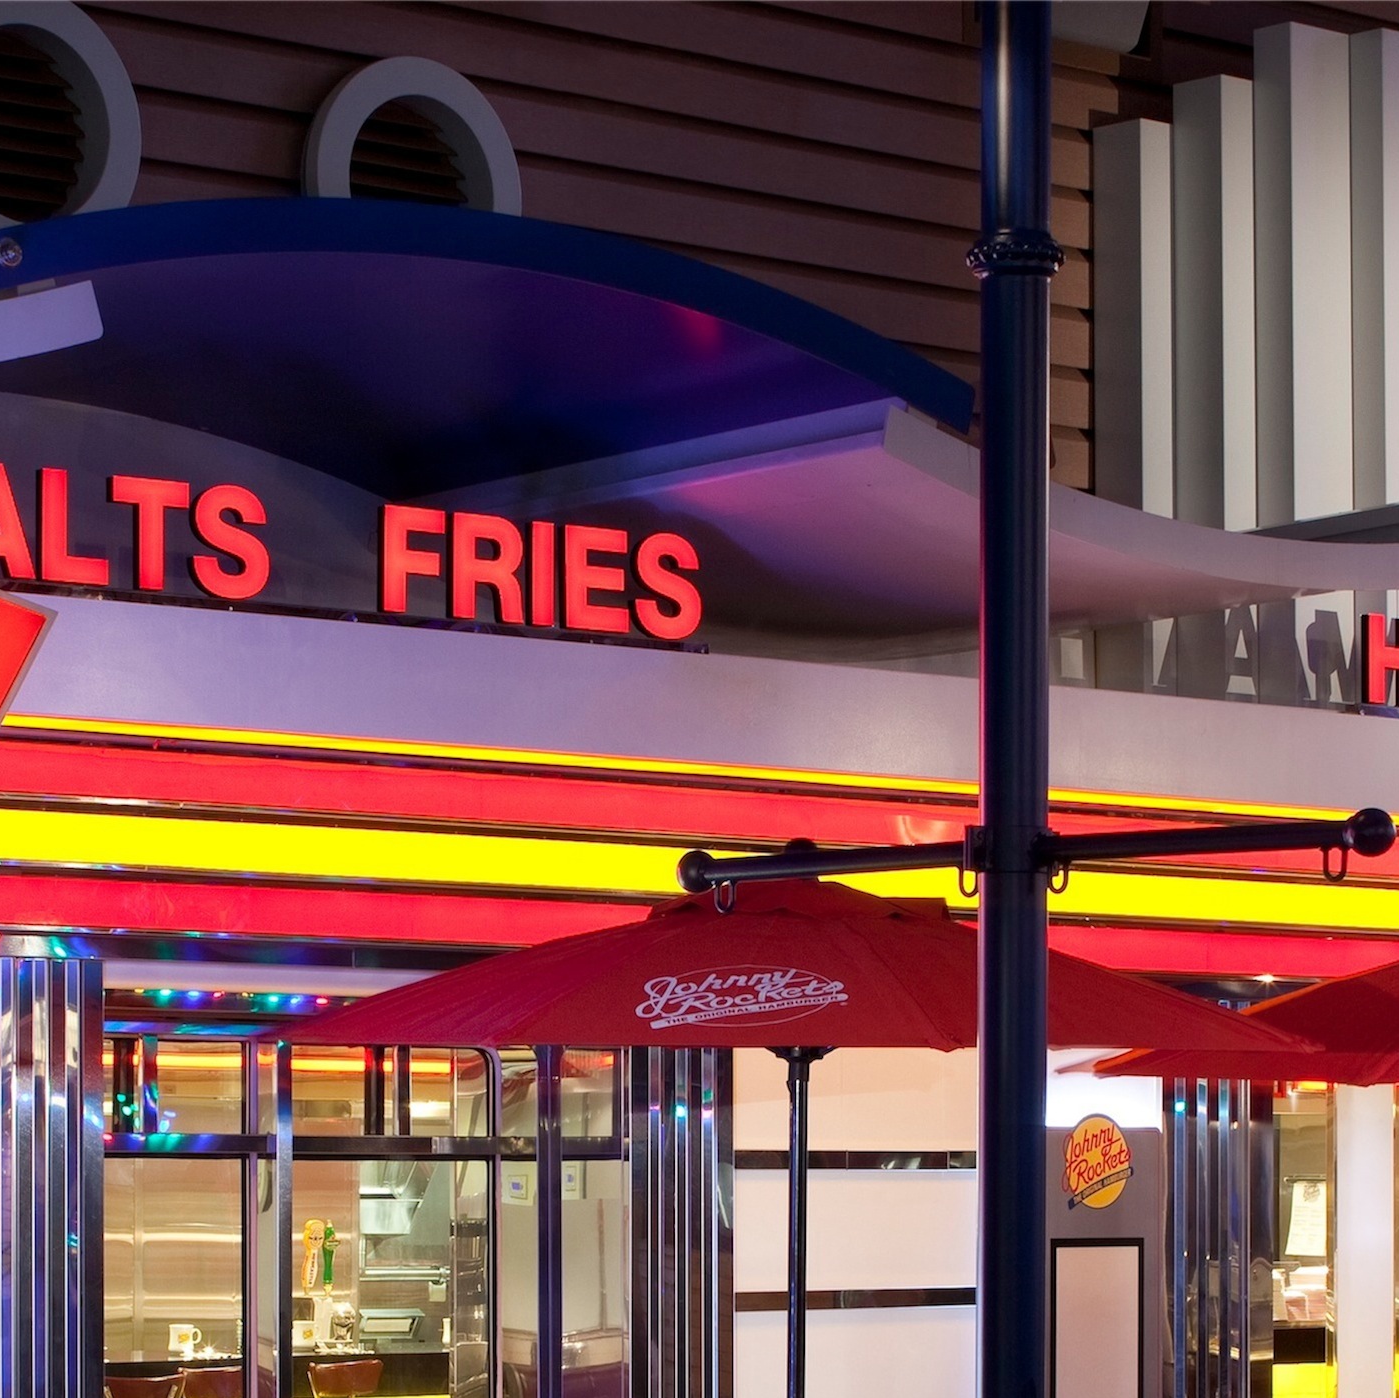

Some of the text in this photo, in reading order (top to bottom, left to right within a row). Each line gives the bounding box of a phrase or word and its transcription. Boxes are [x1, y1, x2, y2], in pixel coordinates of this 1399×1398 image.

[379, 503, 703, 641] FRIES
[635, 968, 814, 1018] Johnny
[659, 980, 845, 1018] Rockets
[666, 995, 840, 1025] THE ORIGINAL HAMBURGER
[1062, 1124, 1121, 1192] Johnny
[1072, 1143, 1132, 1194] Rockets
